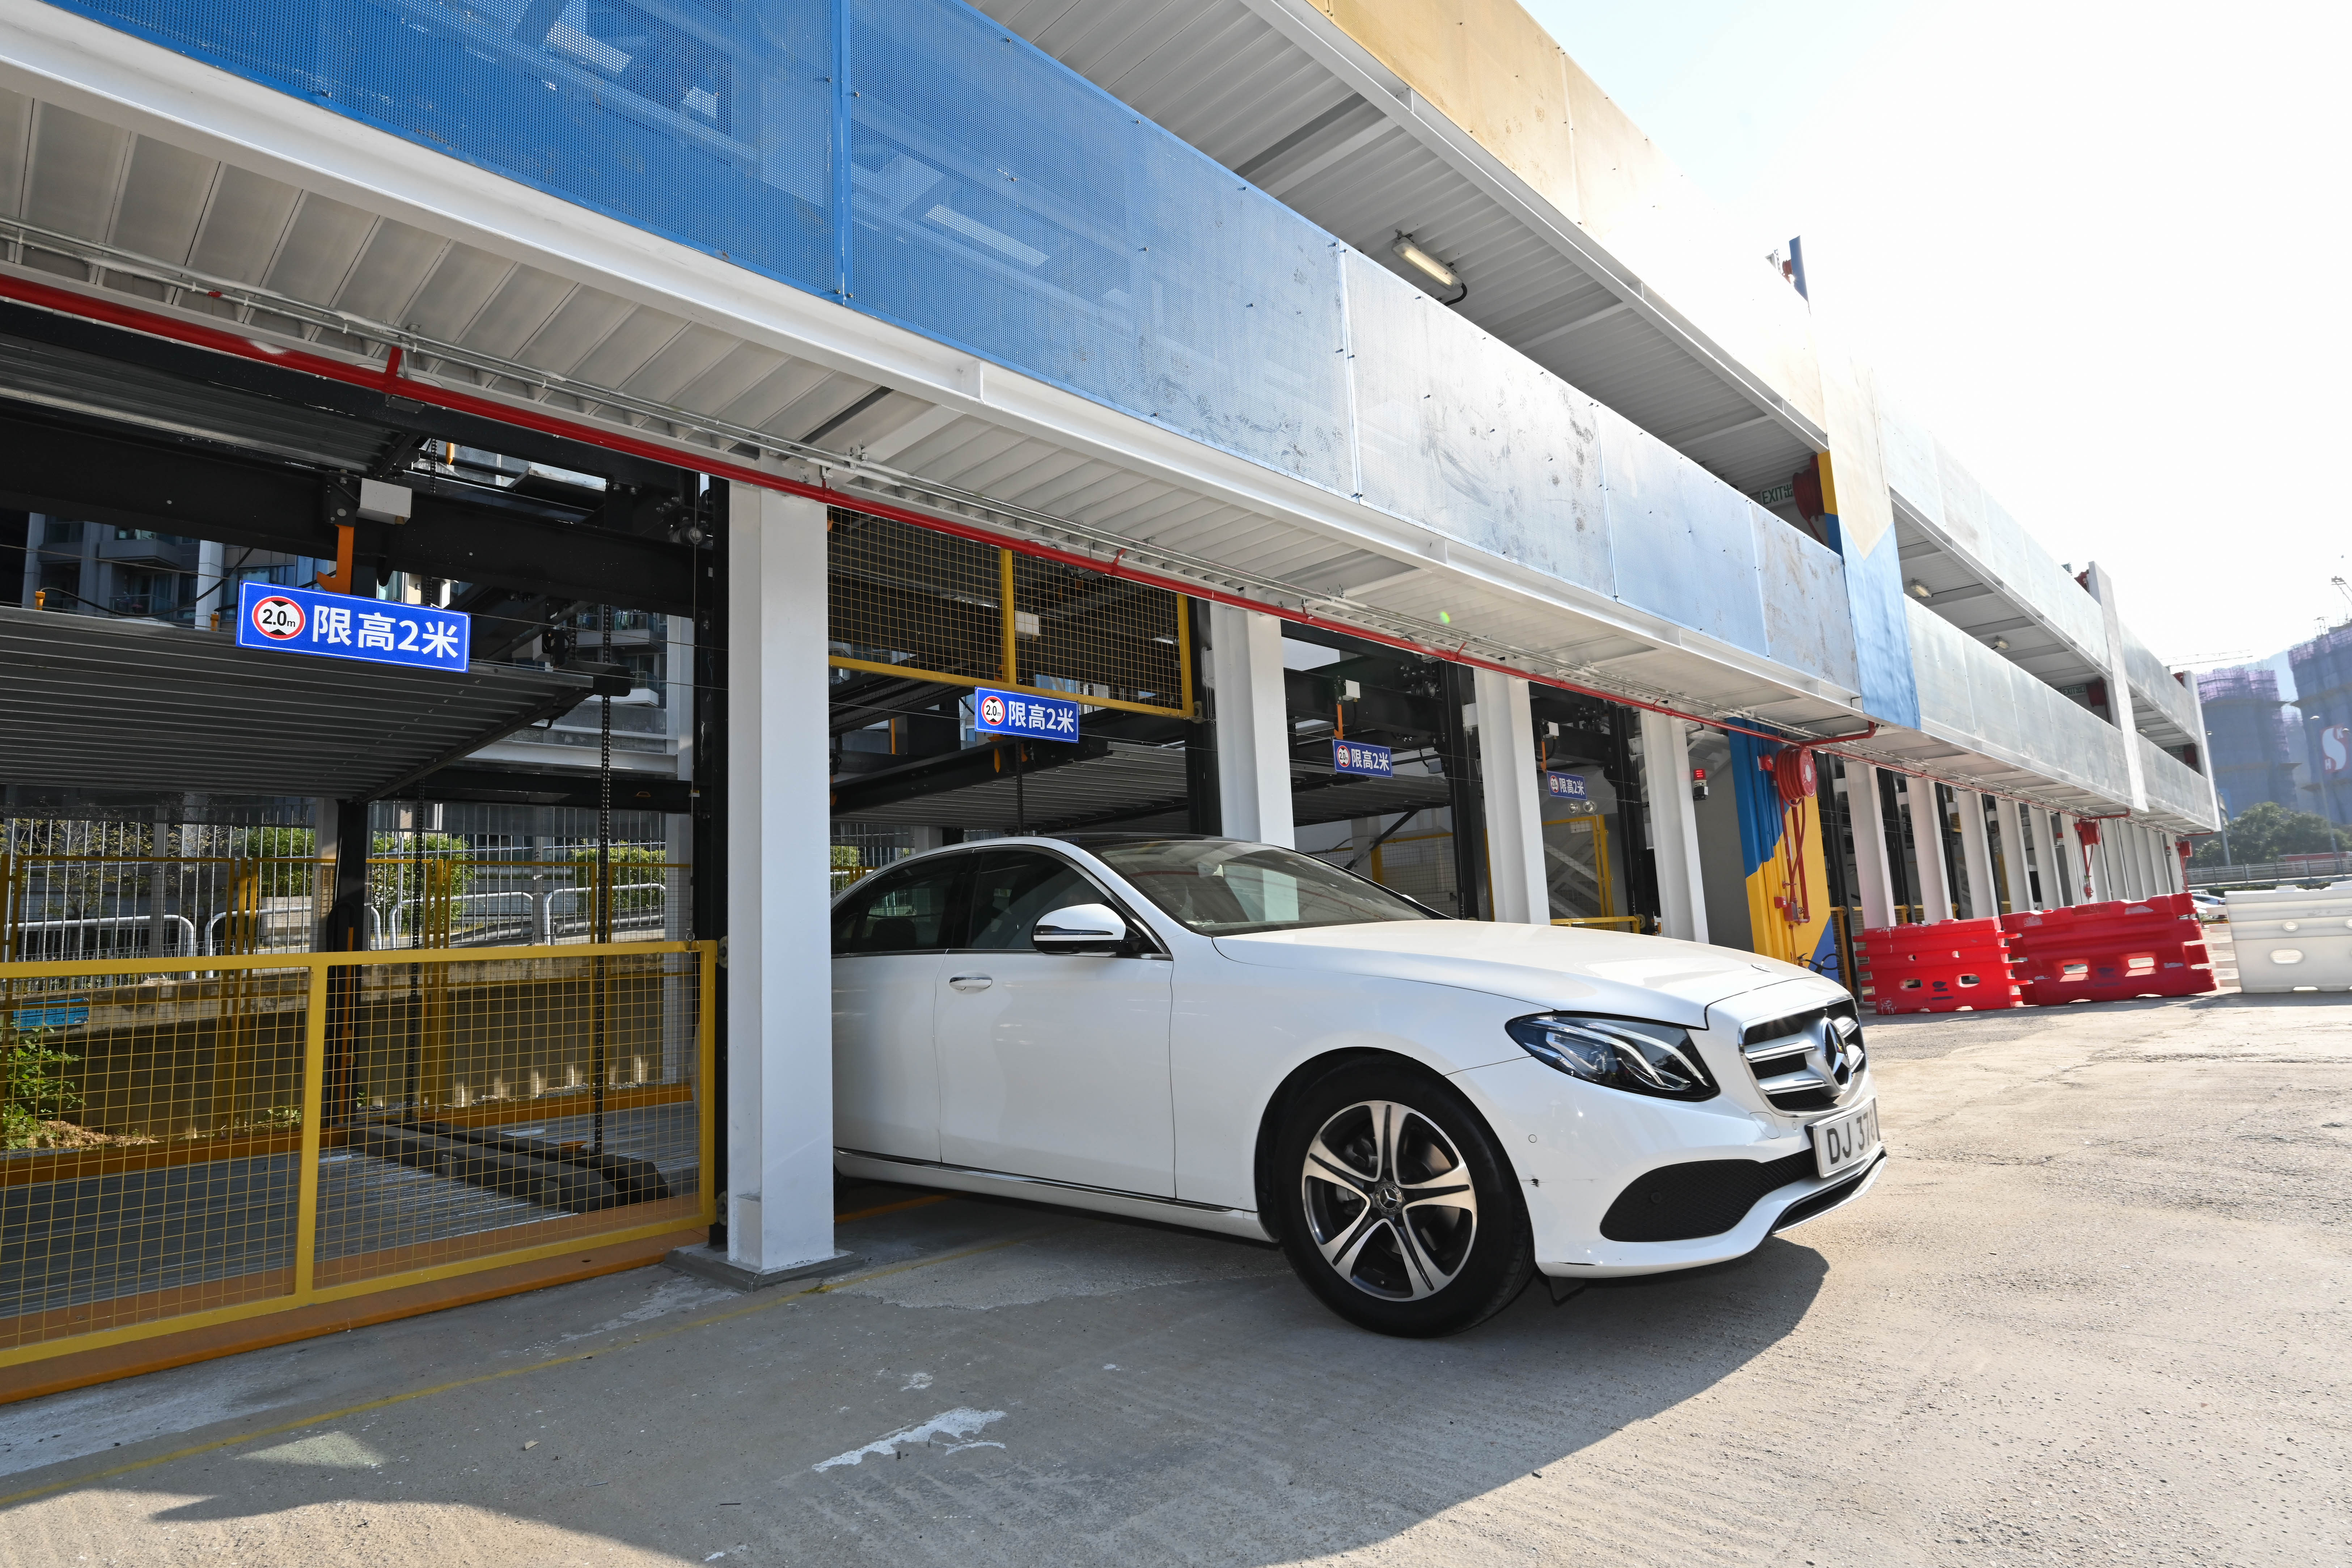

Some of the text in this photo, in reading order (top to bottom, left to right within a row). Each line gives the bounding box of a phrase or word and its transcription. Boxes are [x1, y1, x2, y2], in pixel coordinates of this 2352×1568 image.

[1762, 486, 1783, 505] EXIT
[262, 609, 296, 627] 2.0m
[312, 605, 458, 658] 限高2米
[986, 705, 1001, 717] 2.0m
[1008, 701, 1074, 733] 限高2米
[1351, 748, 1389, 771] 限高2米
[1559, 778, 1585, 795] 限高2米
[1827, 1122, 1851, 1165] DJ
